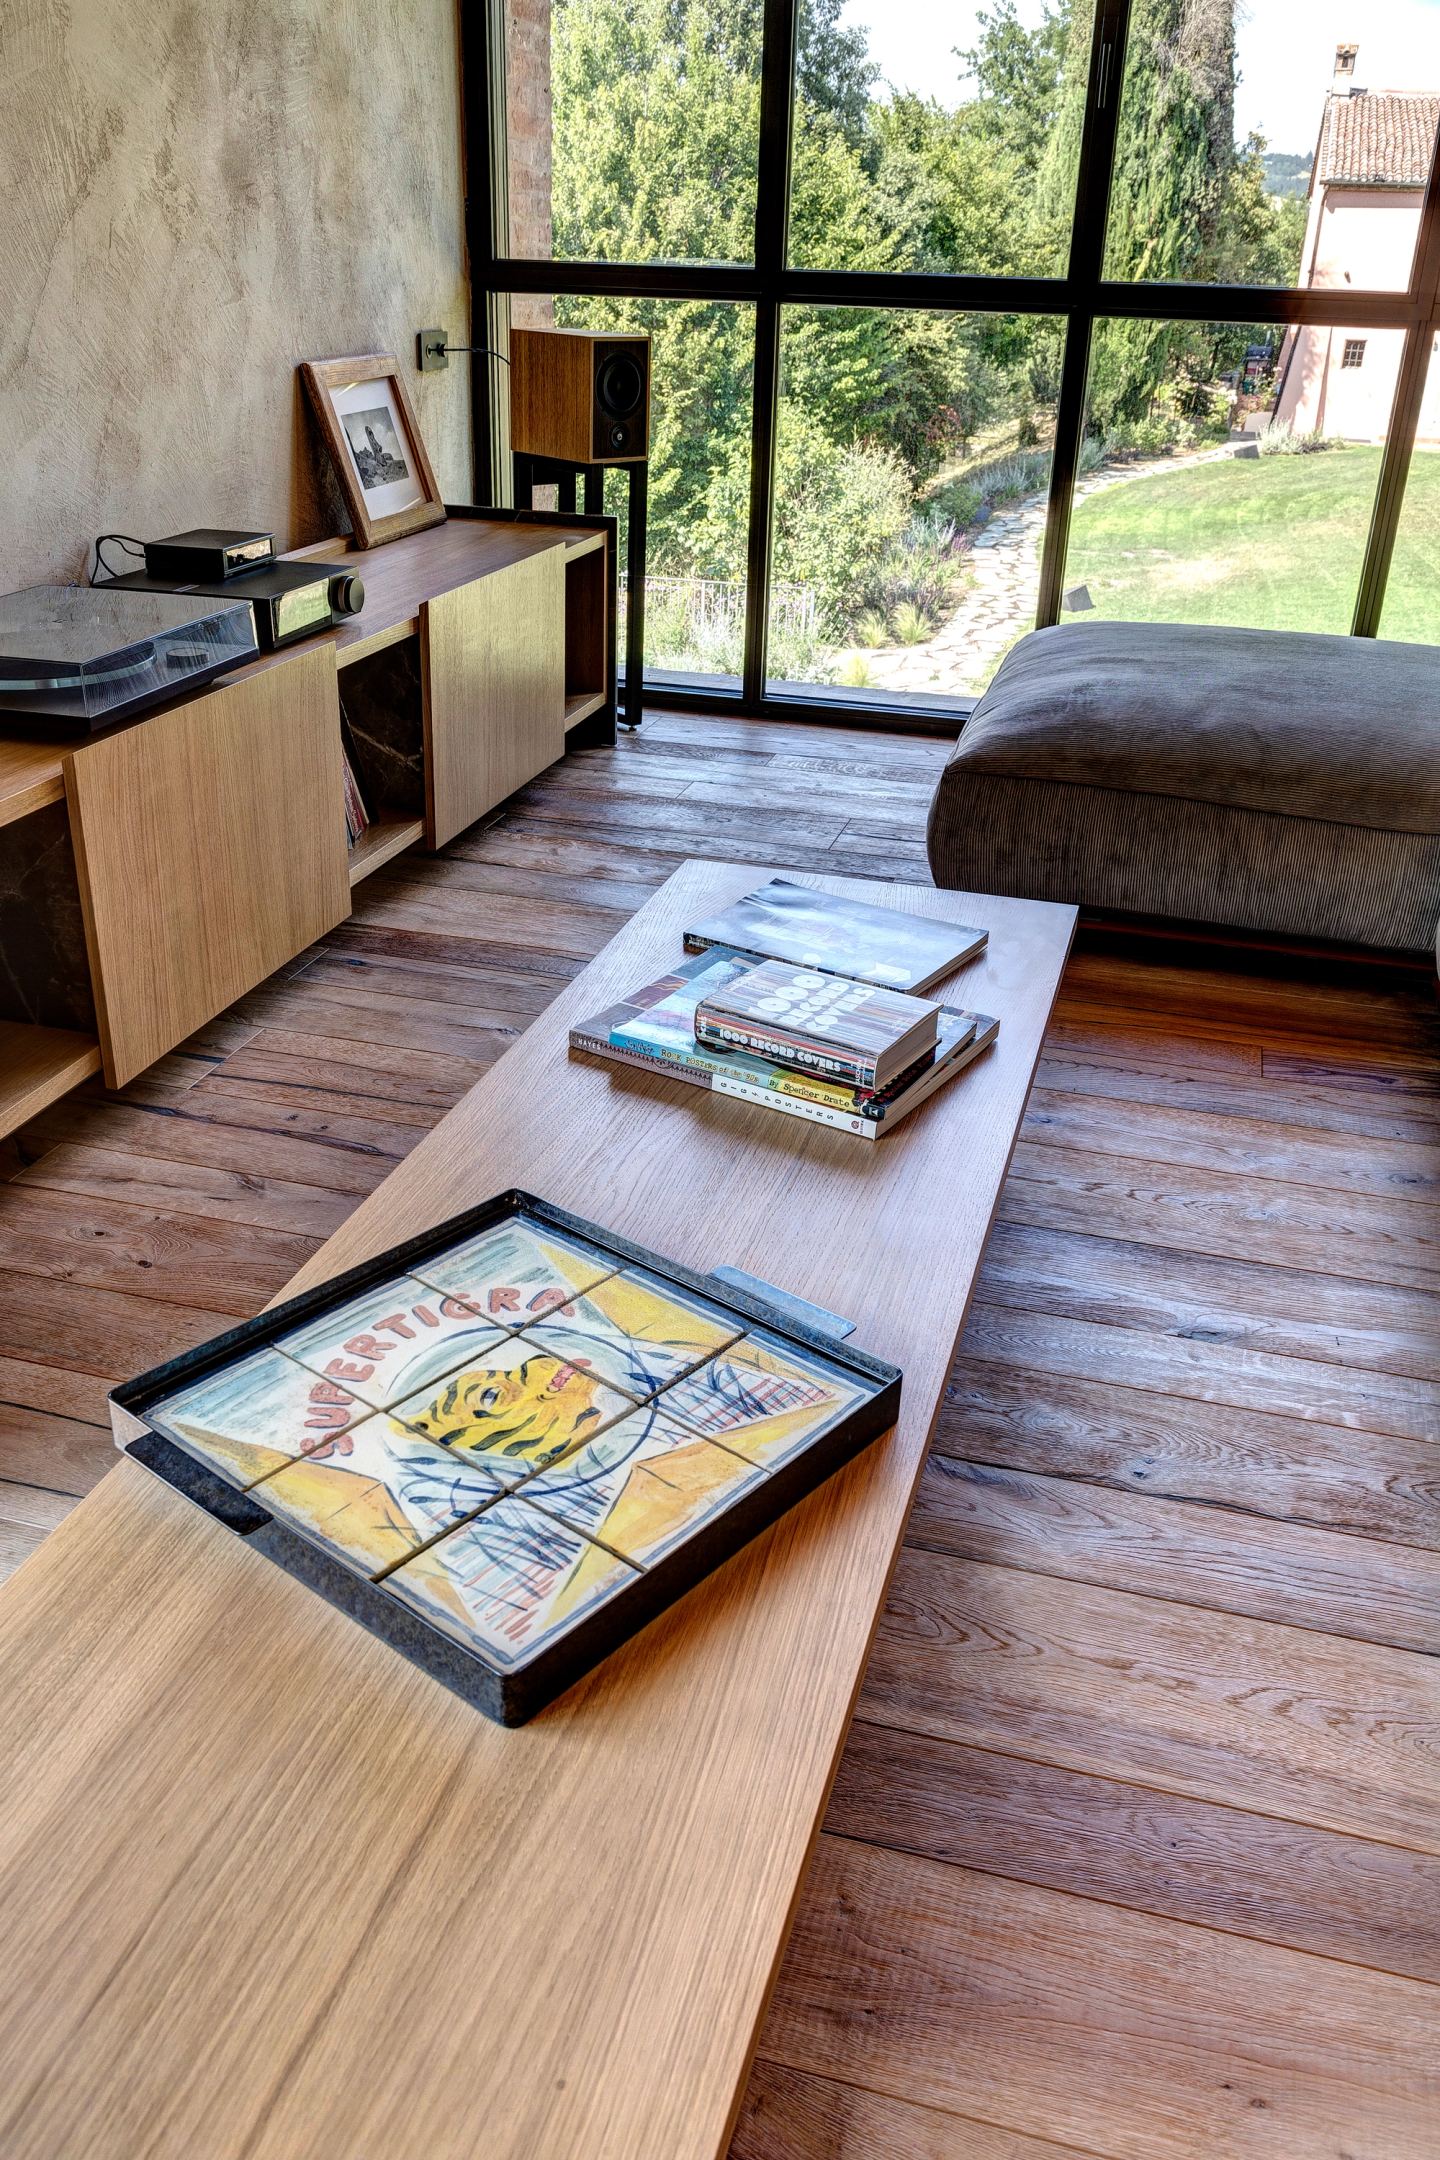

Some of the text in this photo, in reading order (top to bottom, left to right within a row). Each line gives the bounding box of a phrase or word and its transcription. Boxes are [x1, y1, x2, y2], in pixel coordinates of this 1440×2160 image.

[777, 982, 849, 1026] RECORD
[806, 987, 876, 1032] COVERS
[578, 1038, 601, 1051] HAYES
[719, 1028, 841, 1072] 1000 RECORD COVERS
[720, 1082, 834, 1120] GIG POSTERS
[769, 1079, 850, 1108] By Spencer Drate
[299, 1287, 576, 1460] SUPERTIGRA
